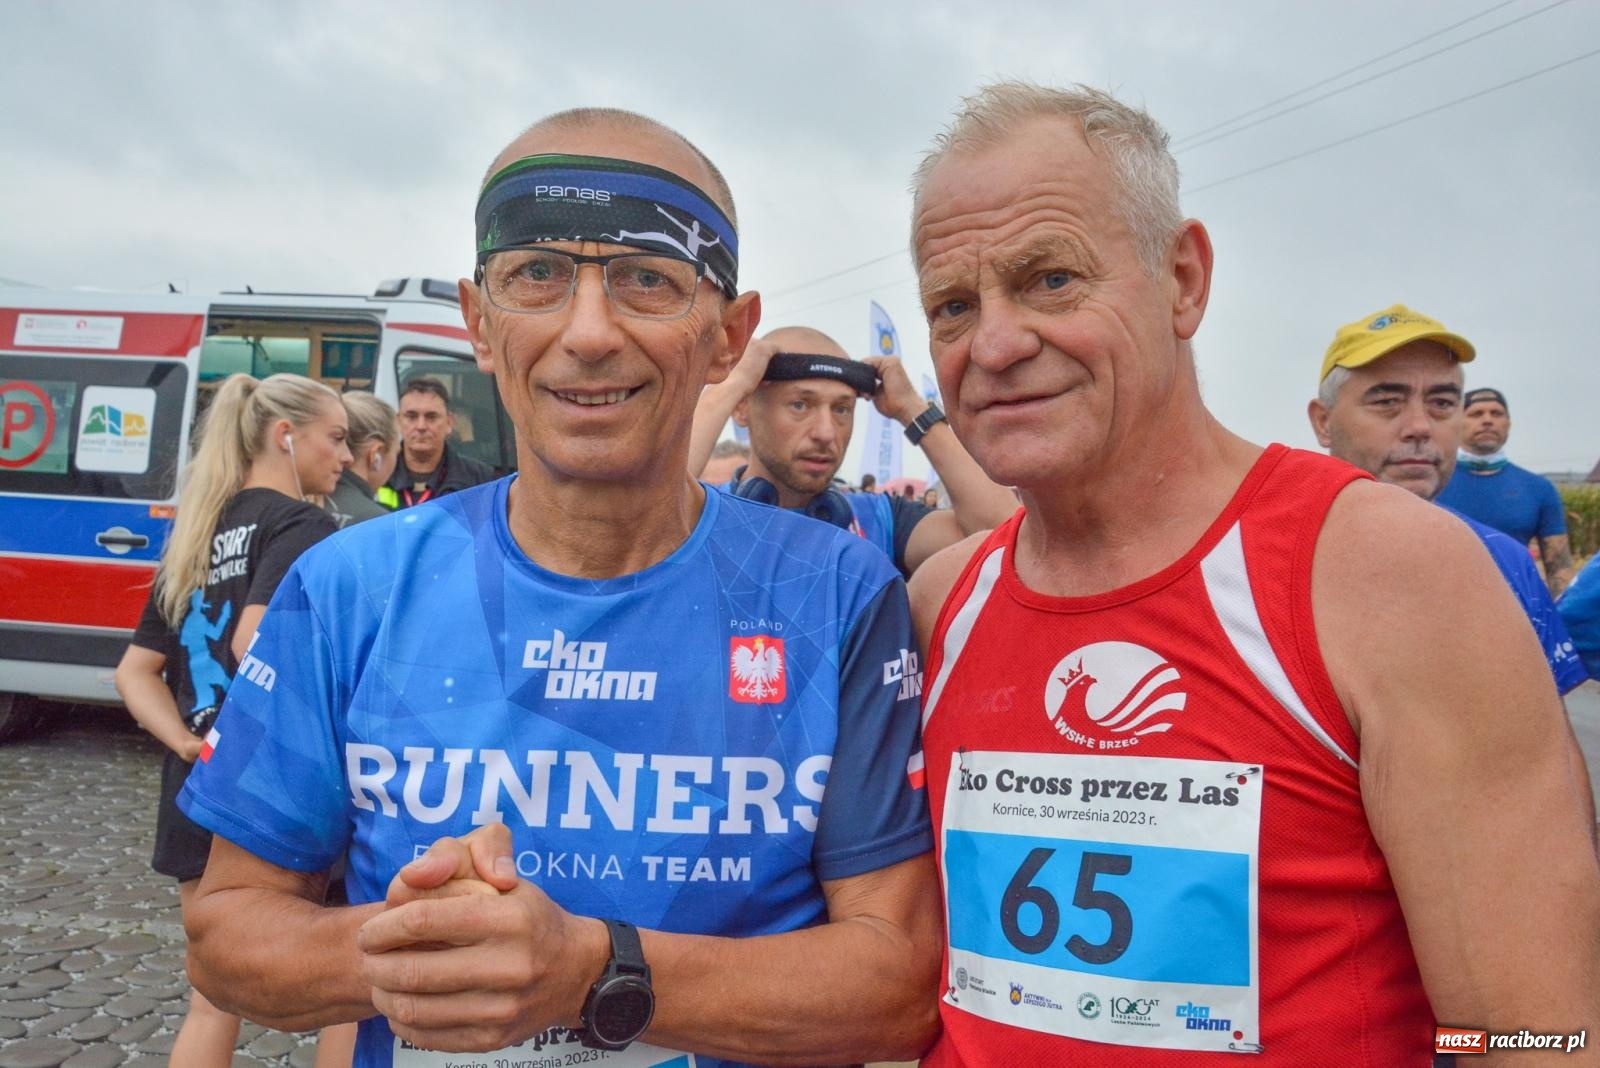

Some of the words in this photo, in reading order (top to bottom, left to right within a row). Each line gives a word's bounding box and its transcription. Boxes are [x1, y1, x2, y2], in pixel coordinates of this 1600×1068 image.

[3, 402, 36, 449] P
[730, 618, 783, 631] POLAND
[1099, 737, 1139, 749] BRZEG
[346, 743, 834, 835] RUNNERS
[996, 769, 1072, 796] Cross
[1080, 778, 1168, 803] przez
[1178, 777, 1239, 807] Las
[993, 802, 1038, 818] Kornice,
[1040, 805, 1055, 818] 30
[1057, 808, 1110, 823] września
[1112, 810, 1146, 825] 2023
[1149, 815, 1158, 826] r.
[516, 850, 625, 881] OKNA
[641, 856, 751, 882] TEAM
[1000, 847, 1134, 965] 65
[564, 1050, 604, 1066] 2023
